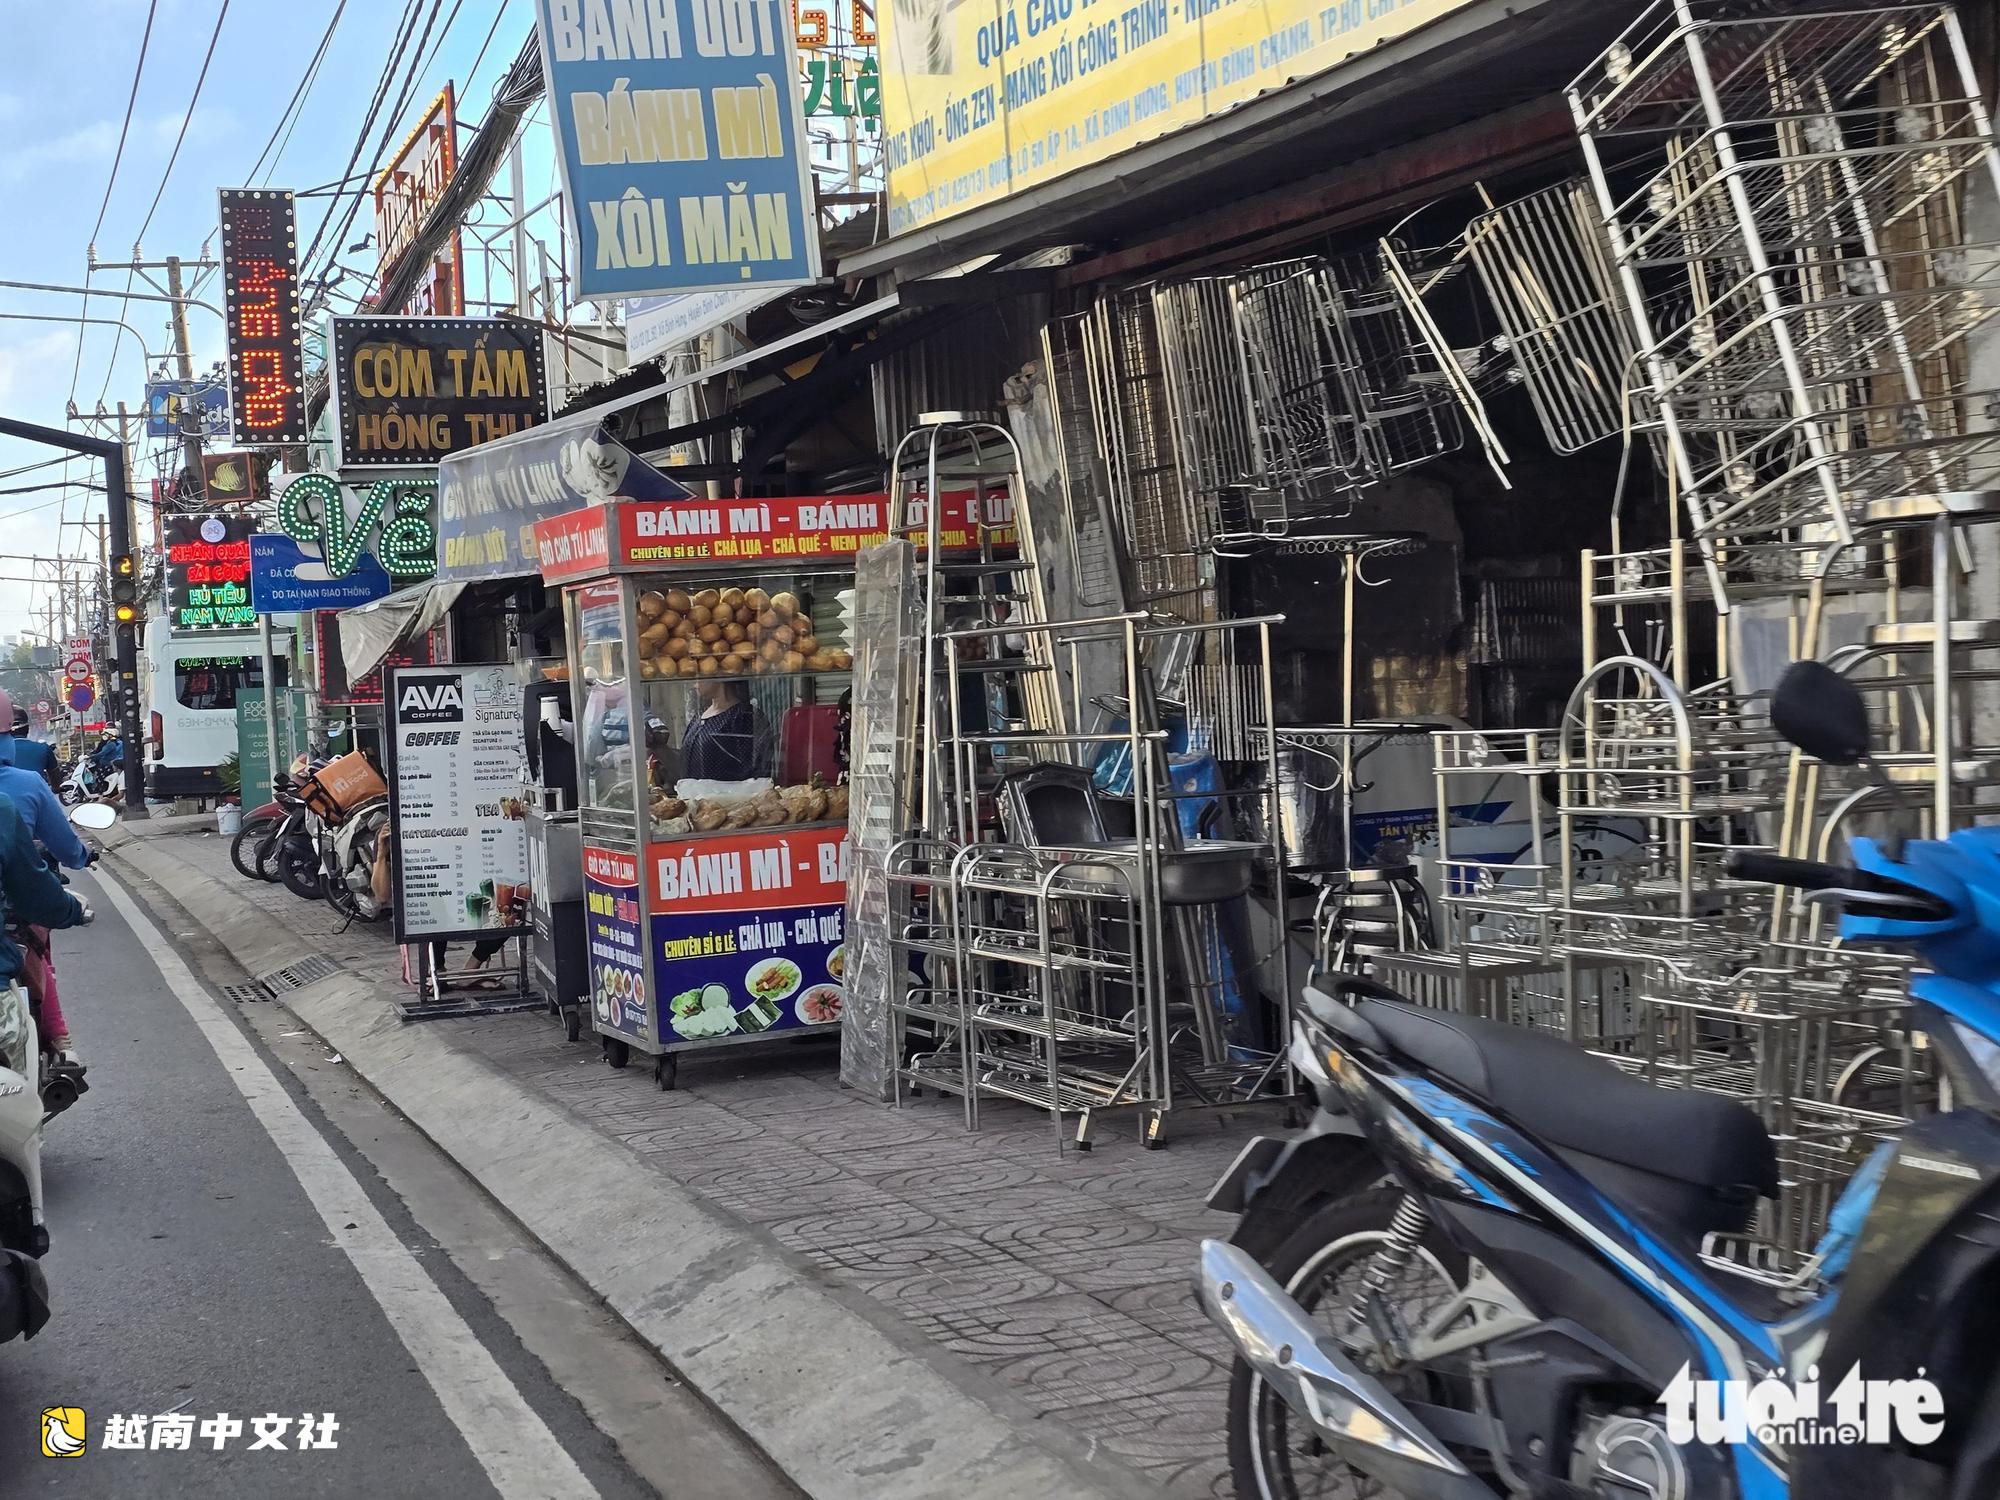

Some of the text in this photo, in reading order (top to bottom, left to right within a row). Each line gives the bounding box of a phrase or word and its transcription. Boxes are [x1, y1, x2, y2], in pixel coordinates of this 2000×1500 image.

[909, 110, 935, 161] KHÓI
[944, 92, 969, 143] ỐNG
[971, 84, 996, 130] ZEN
[1006, 56, 1047, 112] MÁNG
[1077, 20, 1118, 76] CÔNG
[571, 73, 784, 166] BÁNH MÌ
[588, 186, 671, 270] XÔI
[679, 181, 793, 279] MẶN
[354, 331, 530, 398] CƠM TẤM
[357, 402, 450, 450] HỒNG
[636, 500, 720, 537] BÁNH
[728, 502, 771, 533] MÌ
[798, 501, 878, 530] BÁNH
[540, 530, 555, 567] GIÒ
[570, 521, 585, 560] TÚ
[584, 526, 606, 557] LINH
[630, 544, 672, 560] CHUYÊN
[714, 535, 740, 557] CHẢ
[740, 538, 762, 559] LỤA
[772, 532, 797, 554] CHẢ
[797, 531, 822, 555] QUẾ
[830, 535, 858, 551] NEM
[321, 587, 341, 598] GIAO
[342, 586, 371, 597] THÔNG
[181, 607, 214, 625] NAM
[400, 685, 463, 711] AVA
[411, 711, 453, 719] COFFEE
[475, 709, 518, 724] Signature
[405, 731, 461, 747] COFFEE
[475, 803, 500, 817] TEA
[657, 847, 743, 901] BÁNH
[749, 839, 793, 891] MÌ
[664, 935, 702, 959] CHUYÊN
[738, 916, 764, 952] CHẢ
[764, 921, 786, 954] LỤA
[794, 910, 818, 946] CHẢ
[819, 907, 843, 946] QUẾ
